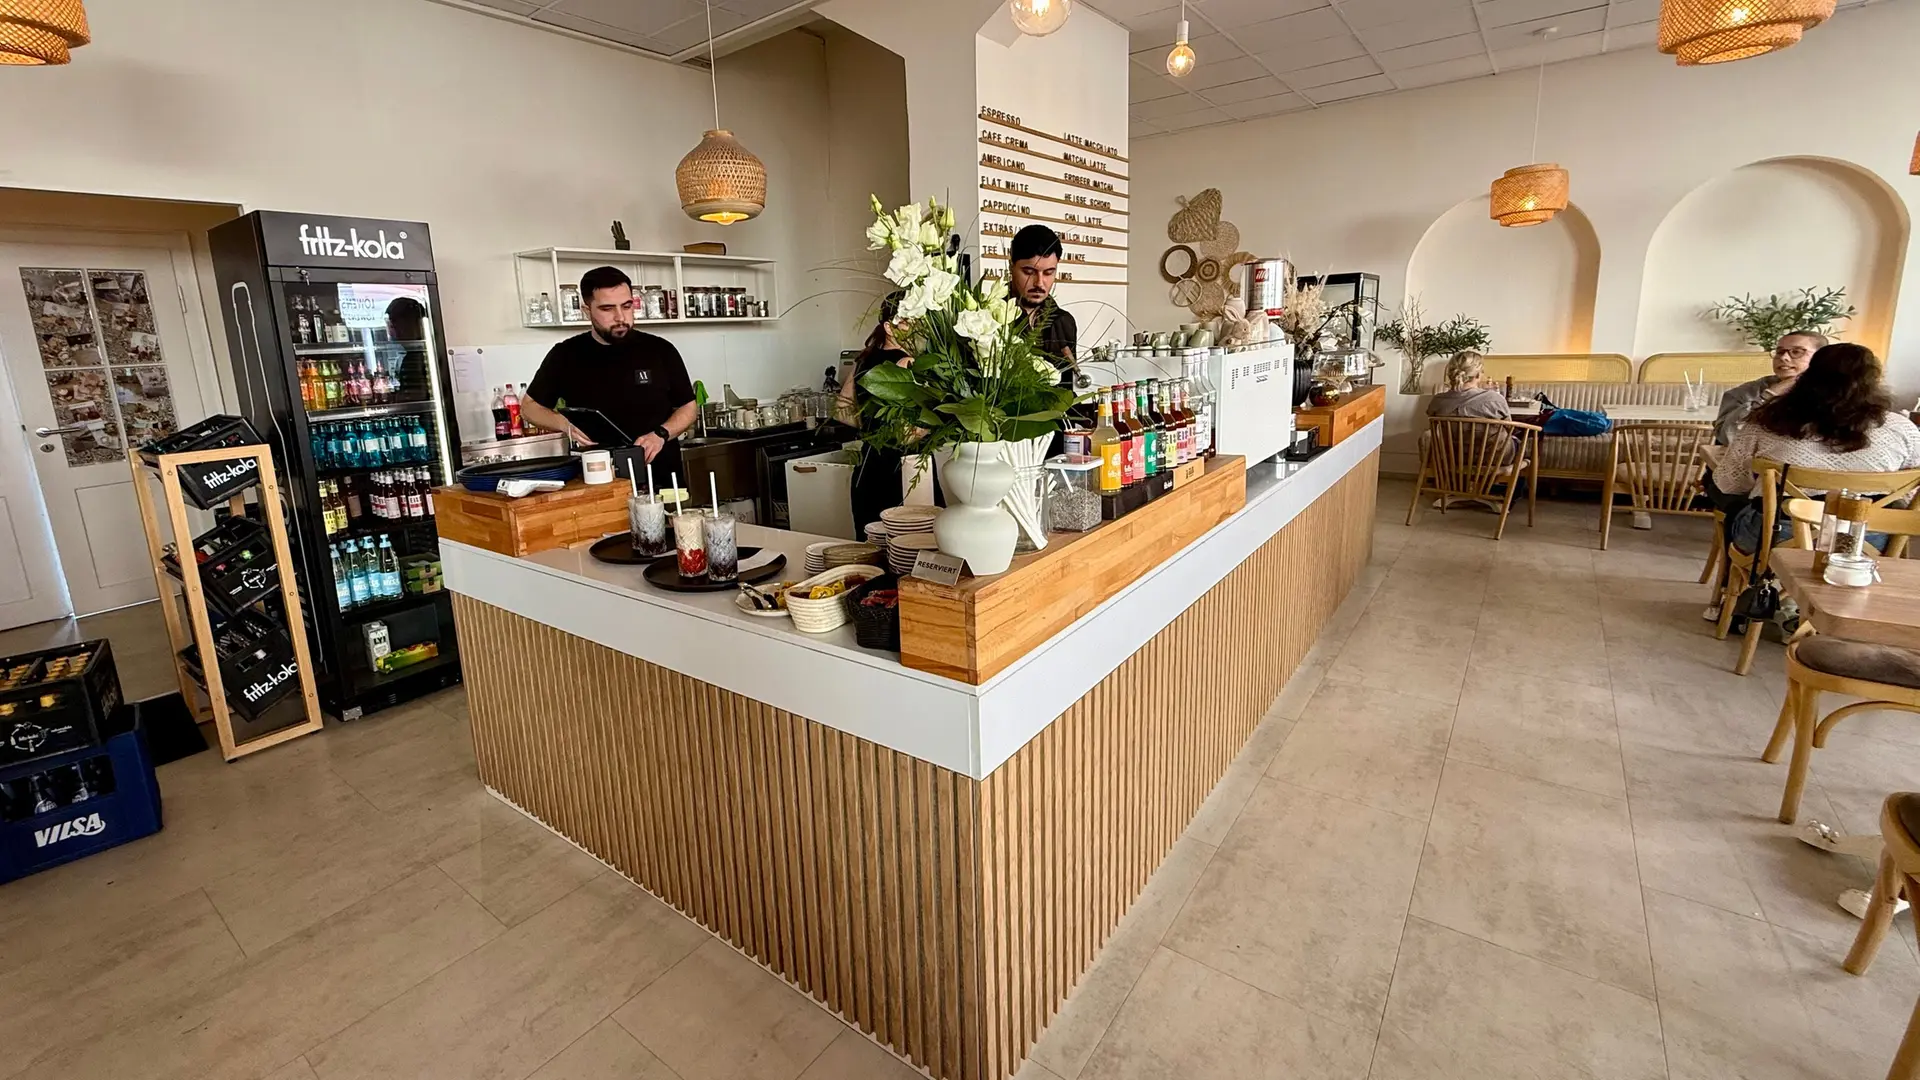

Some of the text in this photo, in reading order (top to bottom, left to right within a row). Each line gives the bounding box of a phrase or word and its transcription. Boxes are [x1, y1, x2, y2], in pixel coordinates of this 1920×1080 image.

[981, 105, 1021, 126] ESPRESSO
[982, 130, 1029, 150] CAFE CREMA
[1063, 132, 1118, 156] LATTE MACCHIATO
[981, 153, 1026, 170] AMERICANO
[1063, 152, 1107, 171] MATCHA LATTE
[981, 176, 1030, 193] FLAT WHITE
[1064, 173, 1114, 192] ERDBEER MATCHA
[983, 200, 1031, 215] CAPPUCCINO
[1064, 193, 1111, 210] HEISSE SCHOKO
[1064, 212, 1103, 226] CHAI LATTE
[983, 222, 1022, 235] EXTRAS/
[982, 245, 998, 256] TEE
[202, 458, 257, 489] fritz-kola
[917, 560, 958, 575] RESERVIERT
[34, 812, 104, 848] VILSA
